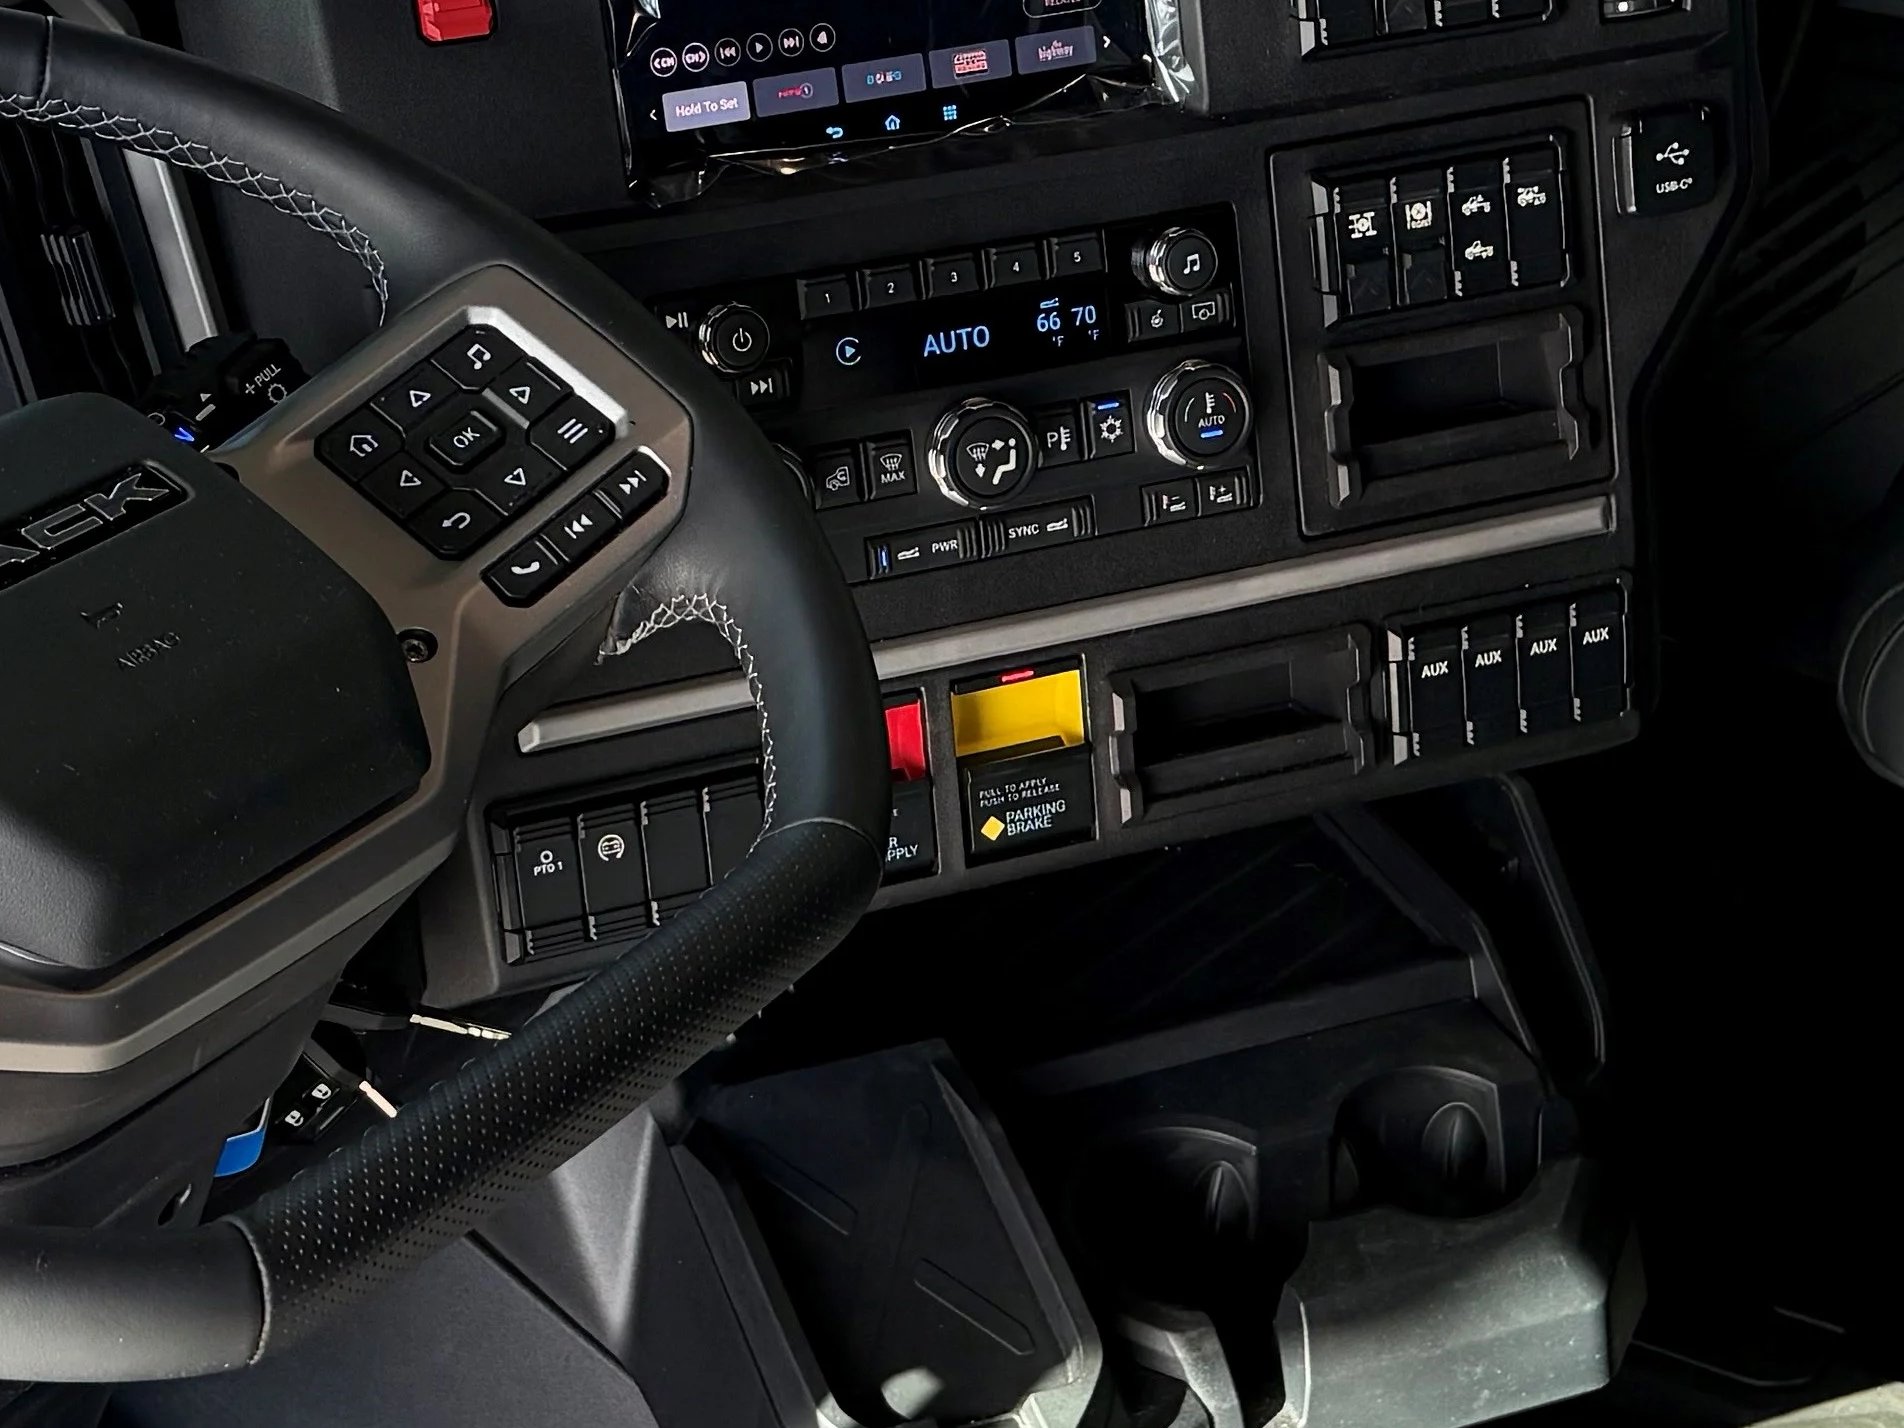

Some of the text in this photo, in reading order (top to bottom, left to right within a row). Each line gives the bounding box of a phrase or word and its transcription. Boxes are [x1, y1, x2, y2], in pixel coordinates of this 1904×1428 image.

[675, 96, 739, 117] Hold To Set
[1072, 251, 1082, 263] 5
[1011, 261, 1020, 273] 4
[950, 271, 959, 283] 3
[886, 282, 895, 294] 2
[824, 292, 831, 304] 1
[1036, 305, 1096, 333] 66 70
[923, 325, 991, 357] AUTO
[254, 363, 282, 387] PULL
[1198, 413, 1225, 428] AUTO
[453, 426, 481, 448] OK
[880, 469, 906, 484] MAX
[1008, 523, 1041, 540] SYNC
[931, 539, 959, 554] PWR
[1583, 627, 1610, 646] AUX
[116, 632, 182, 670] AIRBAG
[1530, 638, 1558, 657] AUX
[1475, 650, 1503, 668] AUX
[1421, 661, 1449, 679] AUX
[979, 777, 1047, 800] PULL TO APPLY
[980, 783, 1060, 808] PUSH TO RELEASE
[1006, 799, 1066, 824] PARKING
[1006, 815, 1053, 837] BRAKE
[886, 844, 919, 862] PPLY
[534, 861, 563, 876] PTO 1
